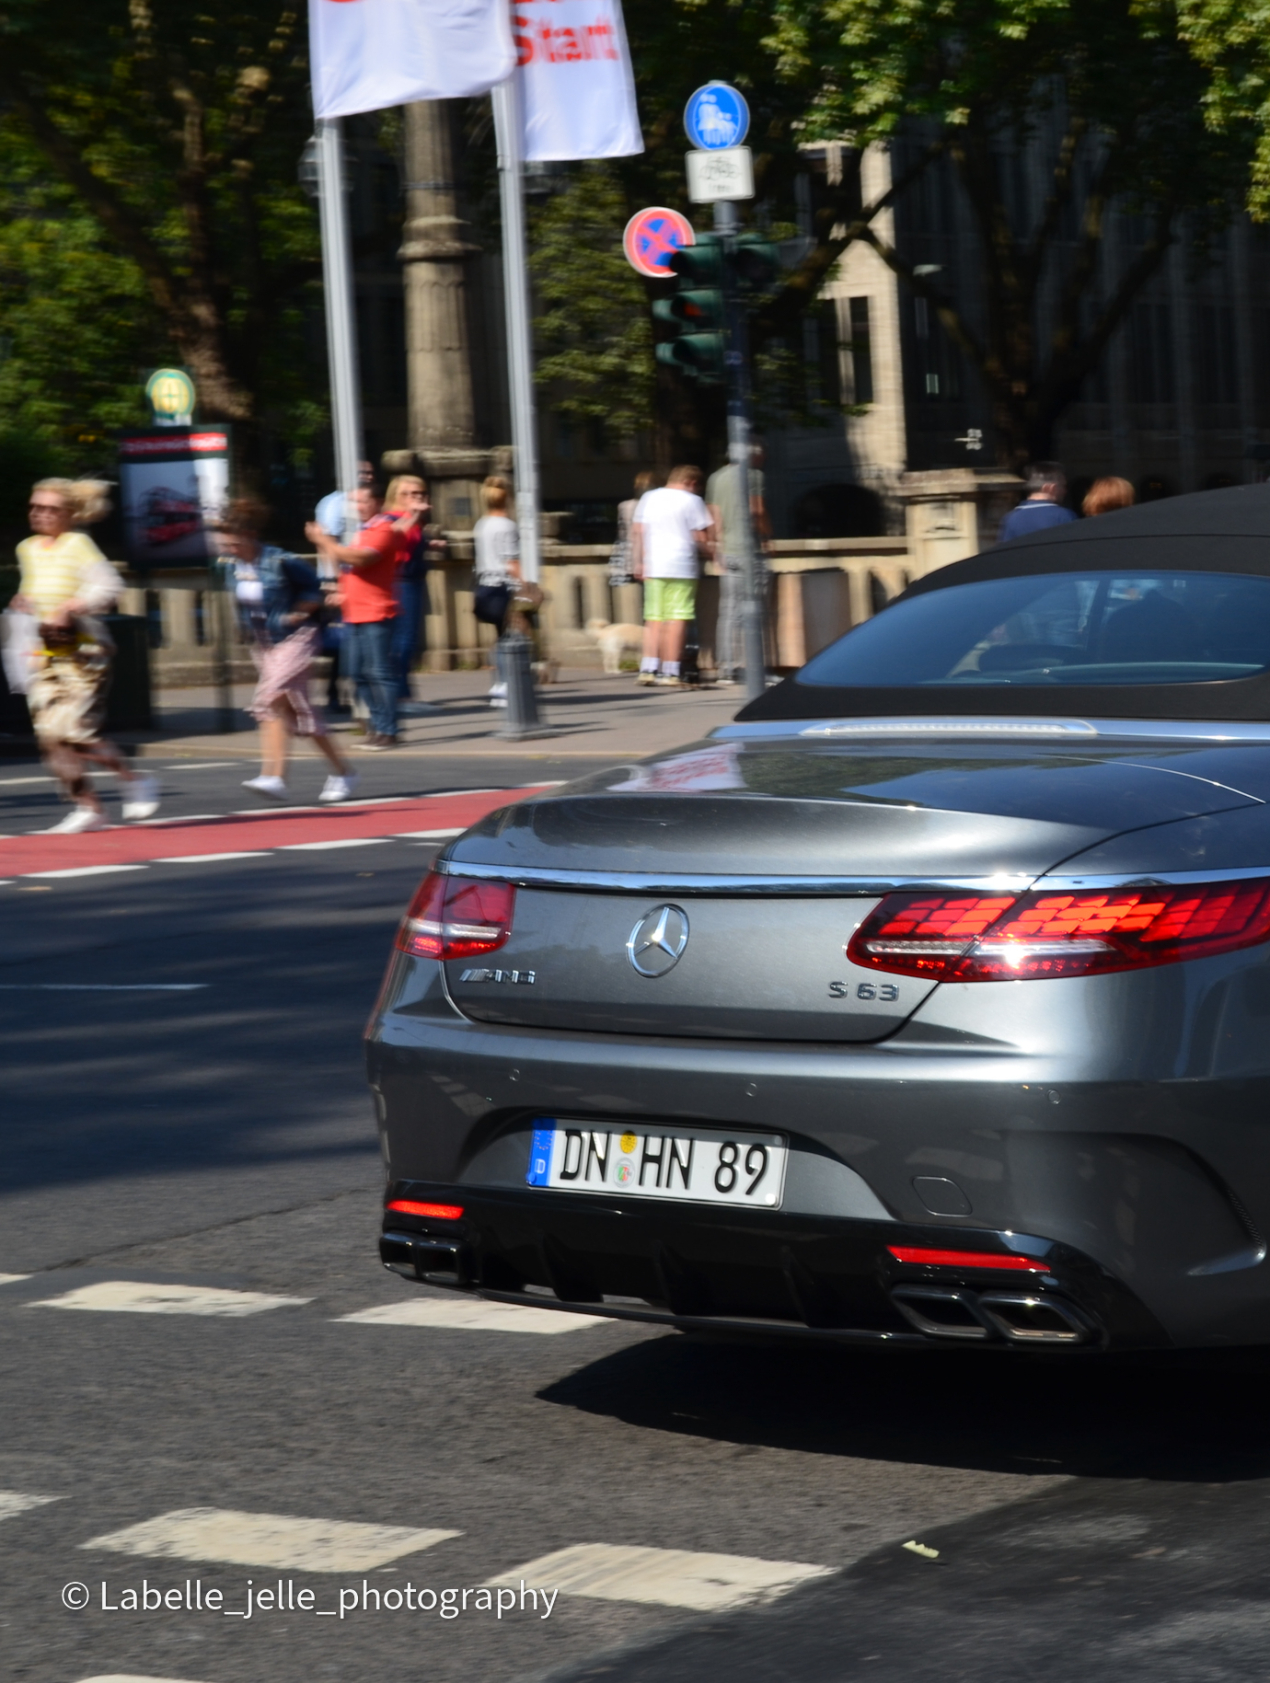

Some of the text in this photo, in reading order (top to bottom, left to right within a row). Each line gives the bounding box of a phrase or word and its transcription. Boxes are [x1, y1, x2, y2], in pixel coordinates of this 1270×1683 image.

[829, 981, 899, 1001] S 63
[560, 1129, 770, 1195] DN HN 89
